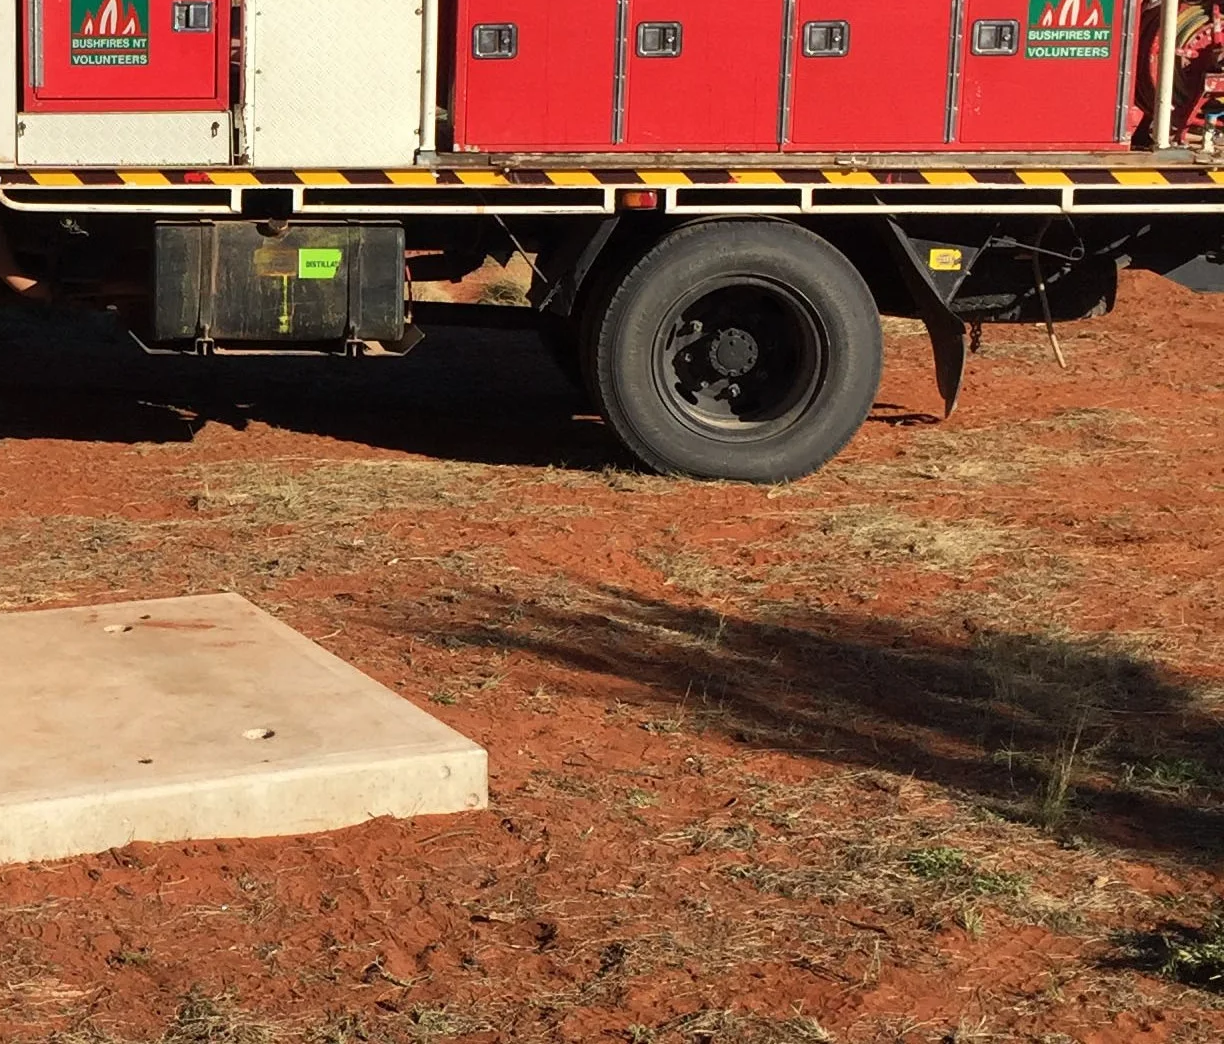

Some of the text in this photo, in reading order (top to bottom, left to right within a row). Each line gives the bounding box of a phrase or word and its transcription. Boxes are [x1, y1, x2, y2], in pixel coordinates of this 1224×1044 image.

[1028, 30, 1109, 40] BUSHFIRES NT
[72, 38, 147, 49] BUSHFIRES NT
[1027, 47, 1109, 57] VOLUNTEERS
[72, 55, 148, 65] VOLUNTEERS
